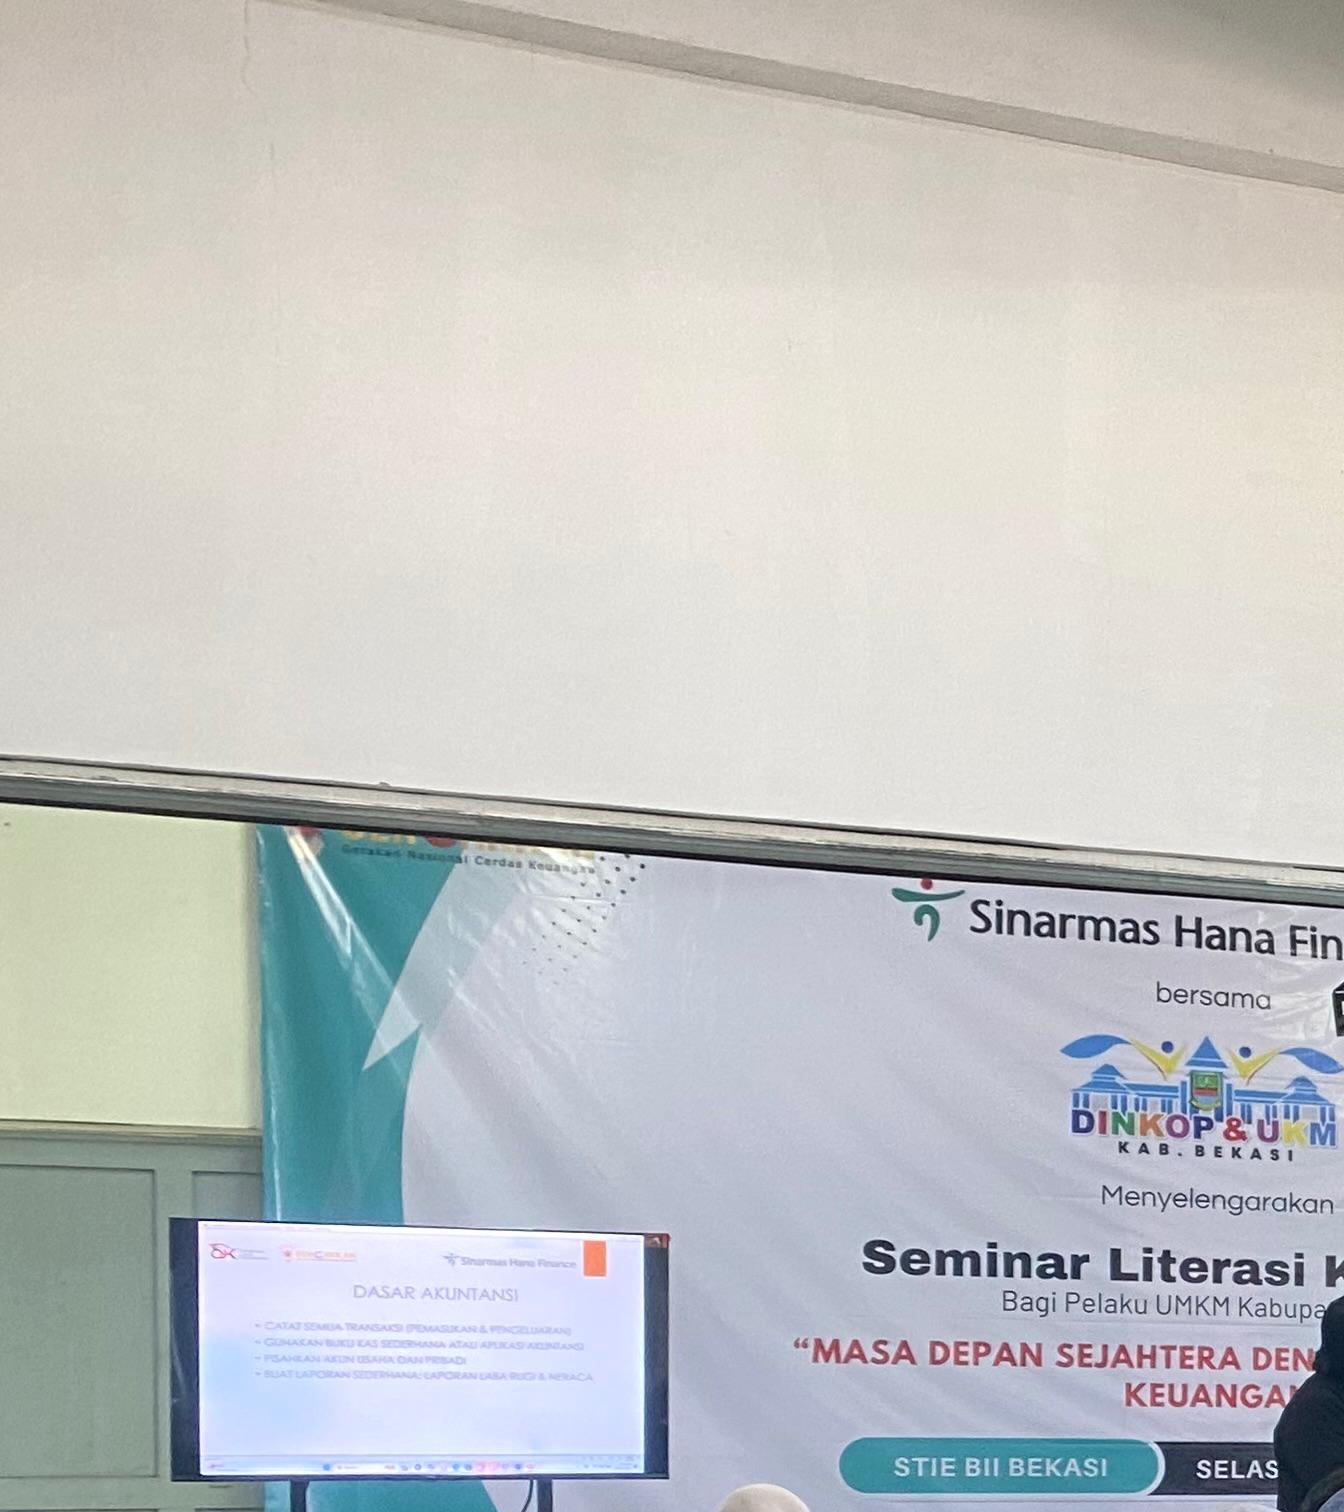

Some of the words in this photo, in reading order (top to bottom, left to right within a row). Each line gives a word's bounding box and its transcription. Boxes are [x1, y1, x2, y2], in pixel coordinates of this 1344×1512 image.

[475, 856, 522, 868] Cerdas
[969, 899, 1160, 945] Sinarmas
[1175, 915, 1275, 954] Hana
[1157, 981, 1271, 1010] bersama
[1071, 1109, 1214, 1140] DINKOP
[1222, 1117, 1248, 1142] &
[1257, 1118, 1337, 1147] UKM
[1118, 1141, 1182, 1157] KAB.
[1195, 1146, 1293, 1162] BEKASI
[1102, 1184, 1334, 1216] Menyelengarakan
[862, 1239, 1090, 1281] Seminar
[1110, 1246, 1305, 1287] Literasi
[353, 1285, 415, 1300] DASAR
[421, 1287, 519, 1302] AKUNTANSI
[1002, 1290, 1057, 1317] Bagi
[1065, 1291, 1147, 1315] Pelaku
[1156, 1294, 1229, 1318] UMKM
[1239, 1296, 1326, 1324] Kabupa
[929, 1340, 1043, 1368] DEPAN
[1055, 1343, 1241, 1371] SEJAHTERA
[1252, 1346, 1316, 1371] DEN
[893, 1457, 956, 1478] STIE
[965, 1457, 999, 1478] BII
[1008, 1457, 1108, 1478] BEKASI
[1196, 1459, 1279, 1480] SELAS
